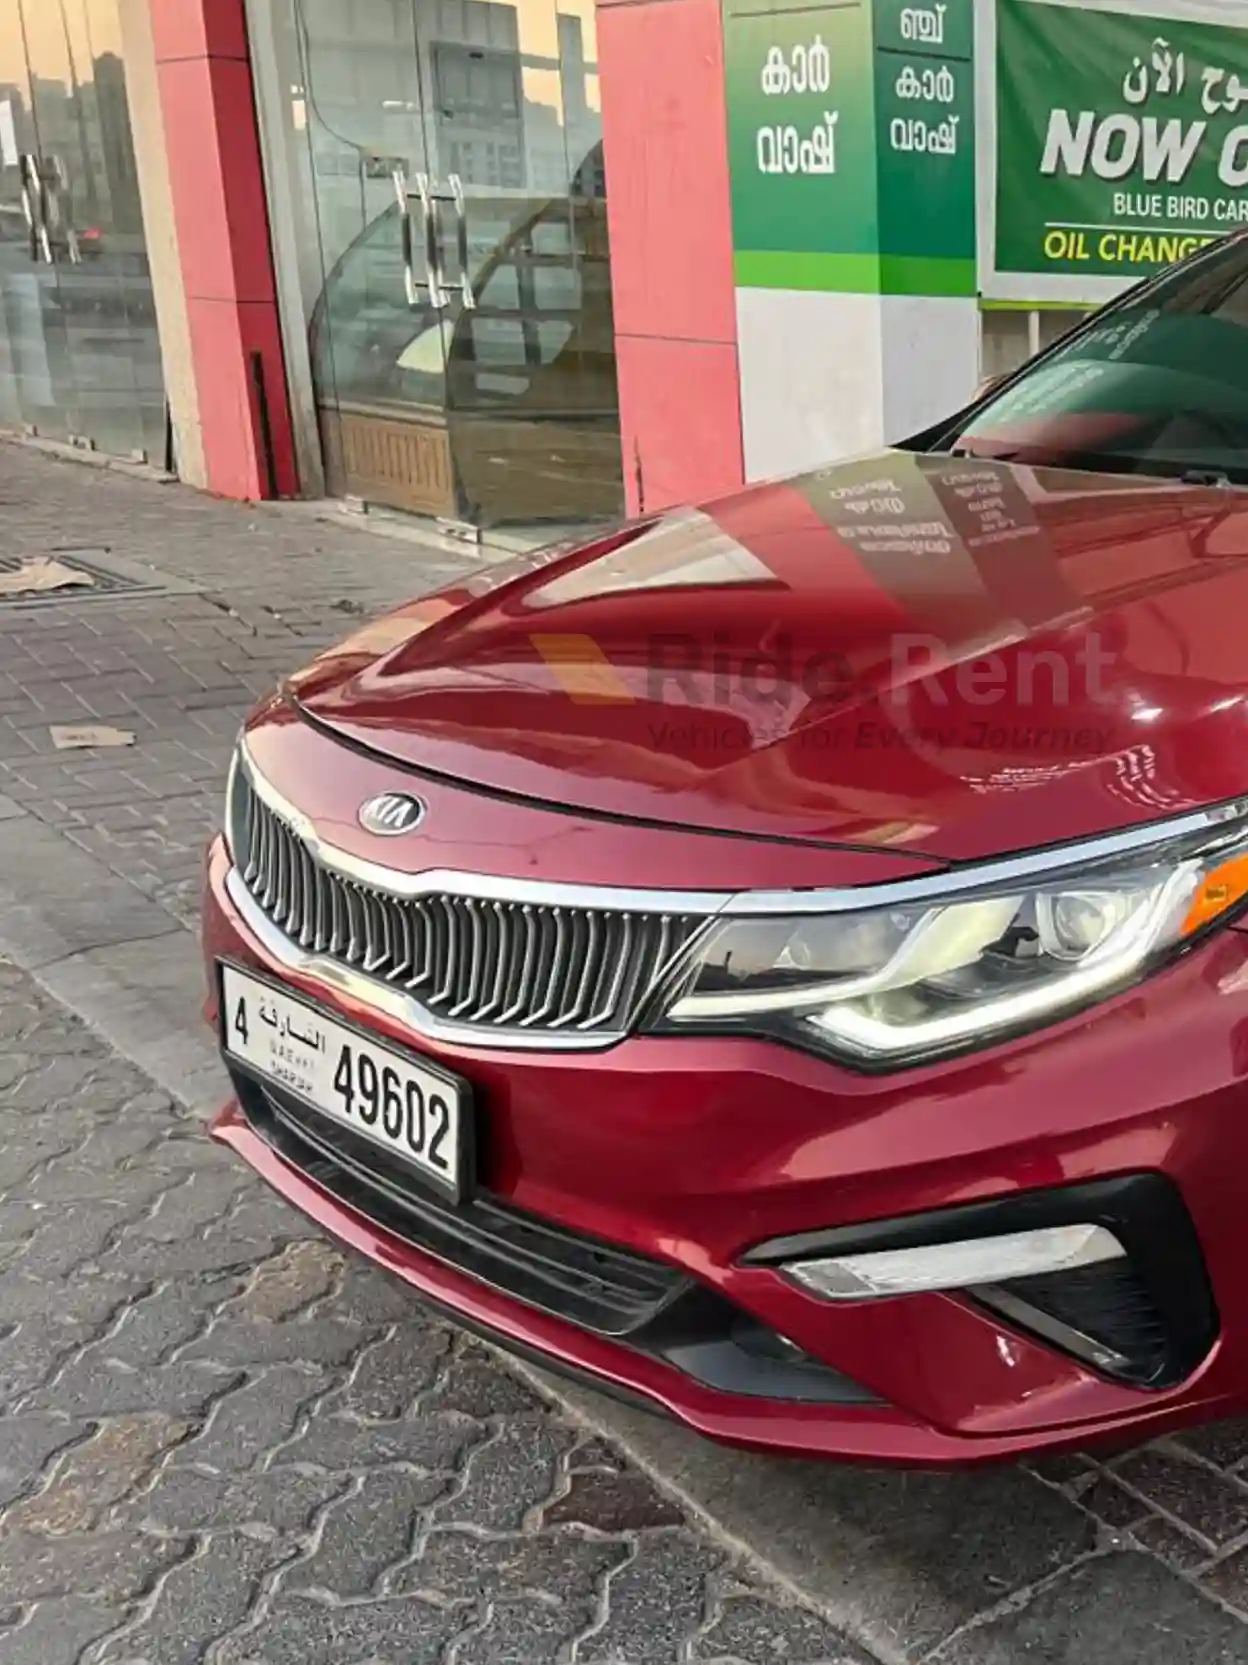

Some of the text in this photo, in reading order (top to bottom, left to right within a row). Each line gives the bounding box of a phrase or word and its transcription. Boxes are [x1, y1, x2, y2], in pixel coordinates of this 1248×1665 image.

[761, 34, 830, 96] കാർ
[895, 66, 954, 103] കാർ
[1122, 36, 1185, 104] الآن
[756, 110, 839, 174] വാഷ്
[890, 115, 960, 155] വാഷ്
[1040, 108, 1207, 183] NOW
[1113, 192, 1162, 218] BLUE
[1166, 195, 1210, 220] BIRD
[1044, 231, 1090, 260] OIL
[235, 996, 248, 1046] 4
[334, 1044, 450, 1170] 49602
